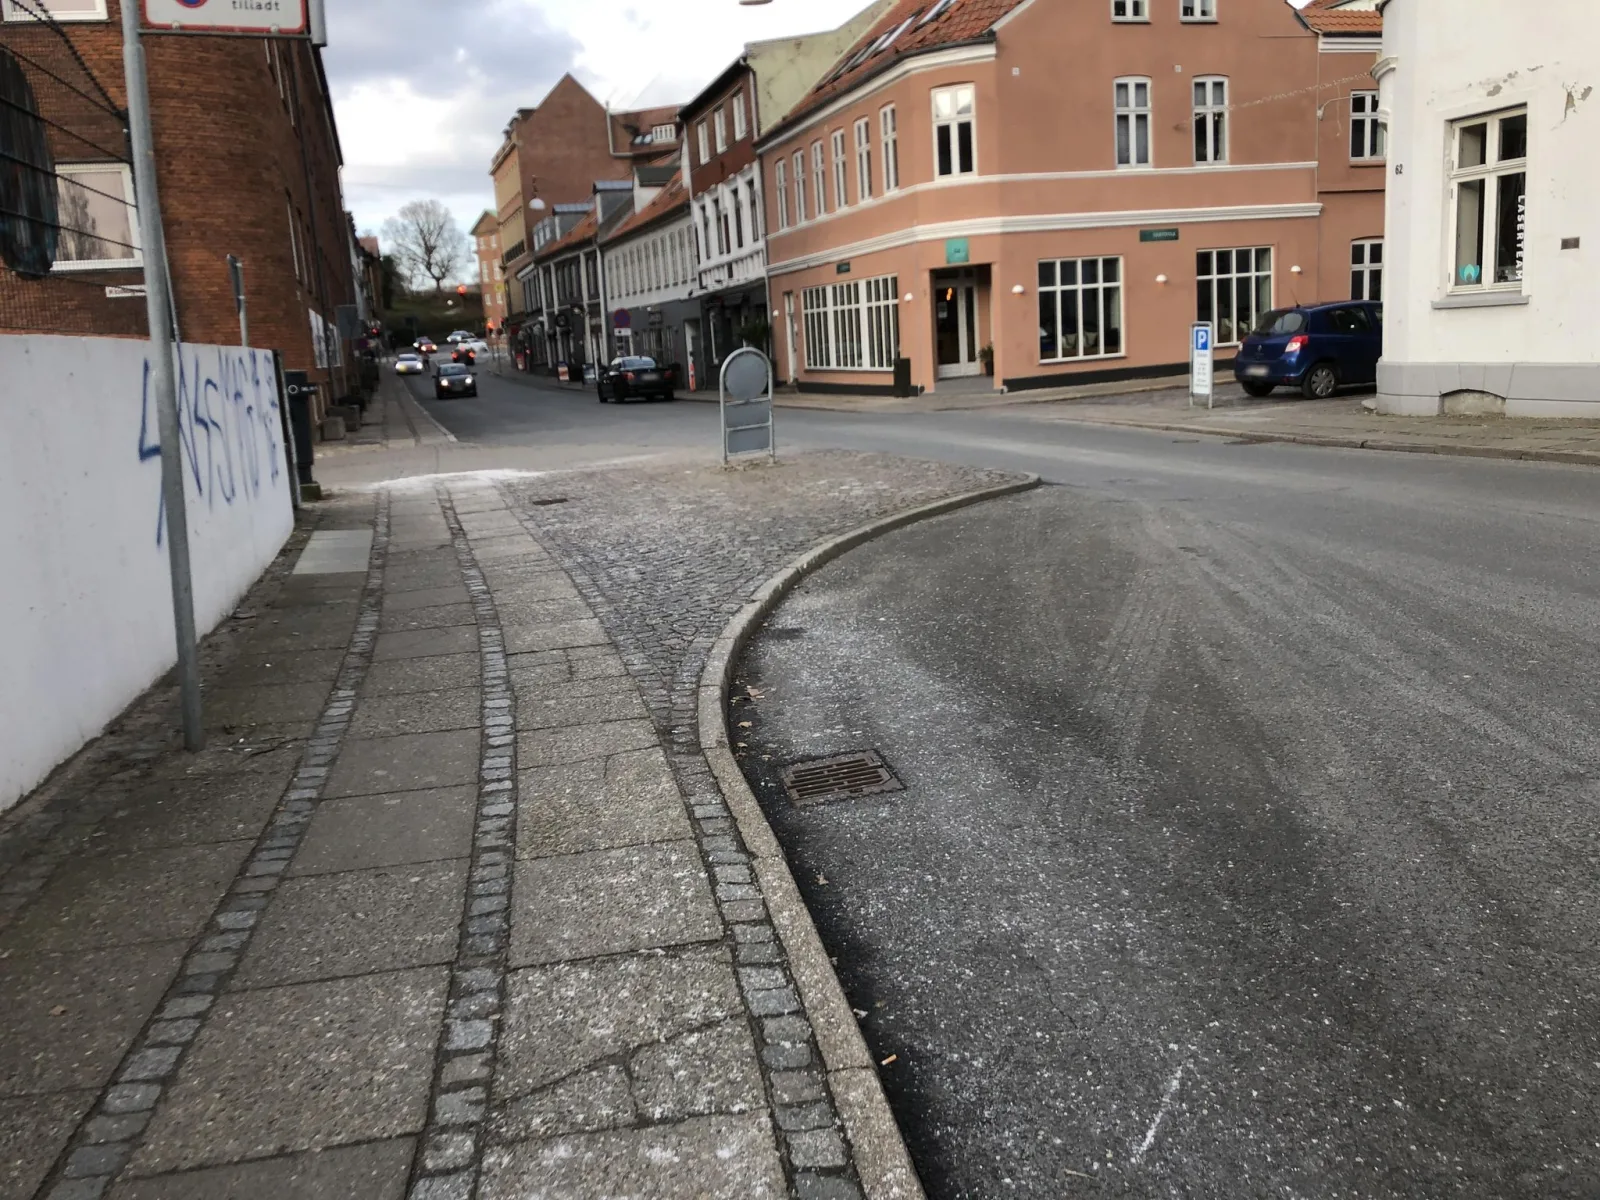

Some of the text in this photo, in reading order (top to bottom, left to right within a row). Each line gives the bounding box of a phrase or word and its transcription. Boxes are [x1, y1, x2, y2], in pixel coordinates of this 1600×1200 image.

[232, 0, 281, 11] tilladt
[1395, 164, 1403, 175] 62
[1515, 195, 1525, 280] LASERTEAM
[1198, 331, 1207, 348] P
